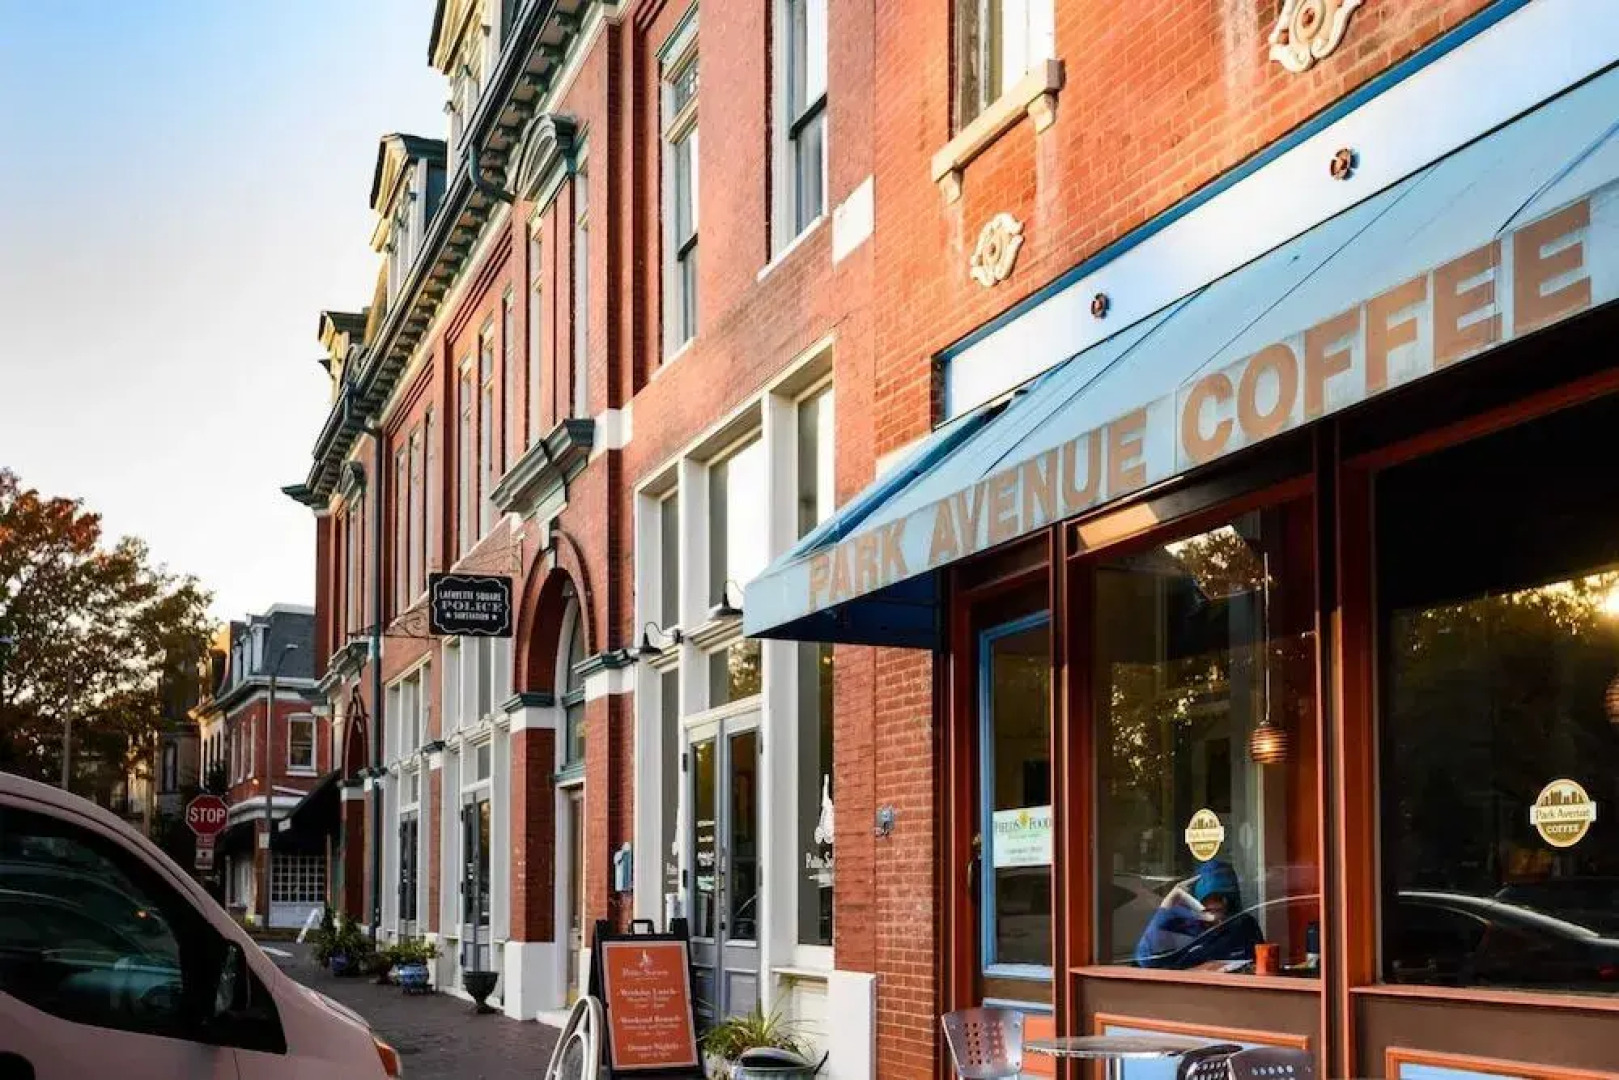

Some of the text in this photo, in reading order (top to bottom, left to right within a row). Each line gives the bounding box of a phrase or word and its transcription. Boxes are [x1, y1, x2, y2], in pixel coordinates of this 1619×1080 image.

[808, 200, 1591, 610] PARK AVENUE COFFEE
[475, 592, 501, 602] SQUARE
[441, 600, 503, 613] POLICE
[190, 807, 226, 824] STOP
